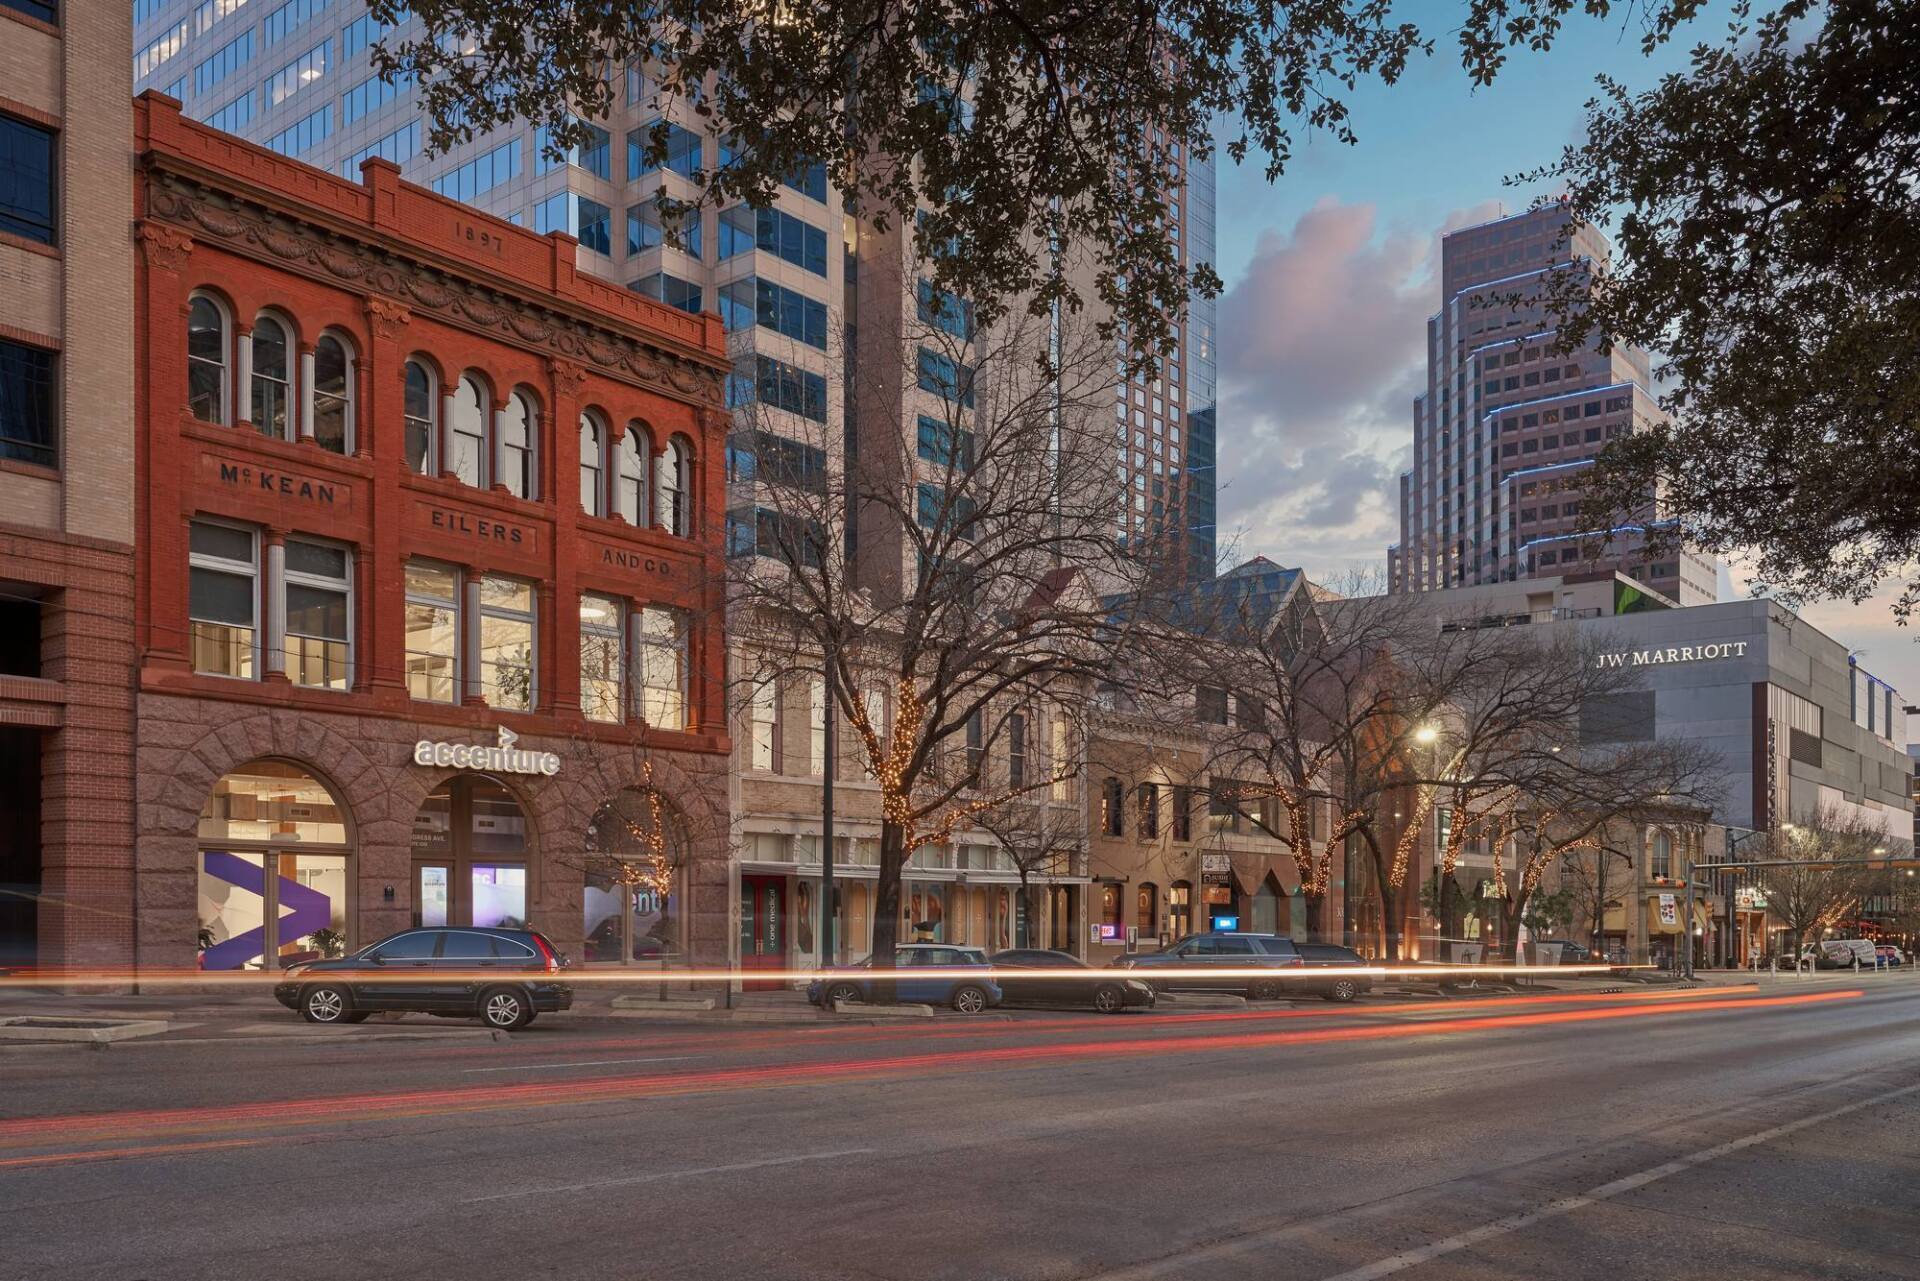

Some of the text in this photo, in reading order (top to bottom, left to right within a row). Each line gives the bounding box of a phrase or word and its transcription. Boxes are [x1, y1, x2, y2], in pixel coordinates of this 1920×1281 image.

[455, 221, 502, 252] 1897
[431, 511, 522, 543] EILERS
[1596, 642, 1747, 668] JW MARRIOTT
[414, 738, 561, 777] accenture
